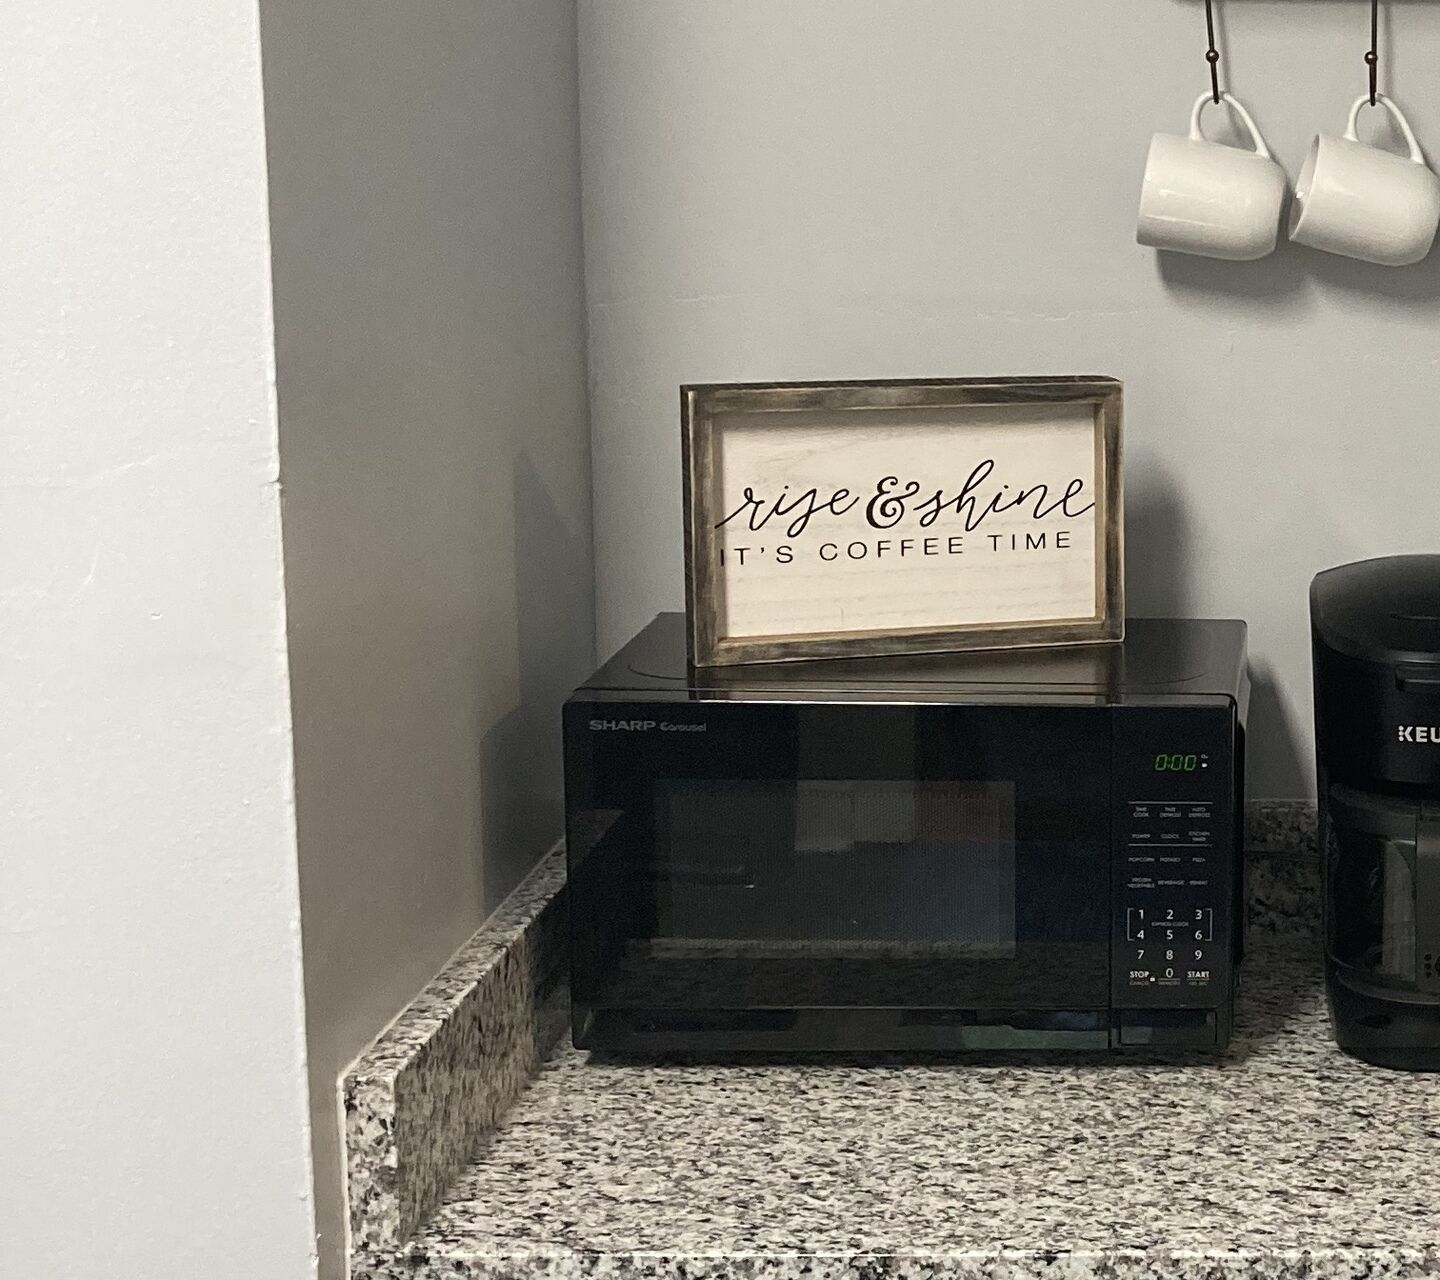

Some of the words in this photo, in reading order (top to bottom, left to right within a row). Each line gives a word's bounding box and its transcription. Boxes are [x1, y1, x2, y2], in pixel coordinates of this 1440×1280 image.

[714, 486, 860, 538] rise
[866, 476, 920, 529] &
[913, 459, 1095, 532] shine
[719, 545, 795, 567] IT'S
[819, 535, 965, 562] COFFEE
[987, 530, 1072, 552] TIME
[589, 720, 656, 731] SHARP
[1155, 754, 1197, 771] 0:00
[1138, 909, 1144, 920] 1
[1166, 909, 1174, 920] 2
[1195, 909, 1203, 920] 3
[1136, 929, 1145, 940] 4
[1166, 929, 1174, 940] 5
[1195, 930, 1203, 940] 6
[1137, 950, 1145, 960] 7
[1166, 950, 1174, 960] 8
[1194, 950, 1203, 960] 9
[1129, 970, 1150, 978] STOP
[1165, 968, 1174, 978] 0
[1187, 970, 1210, 978] START
